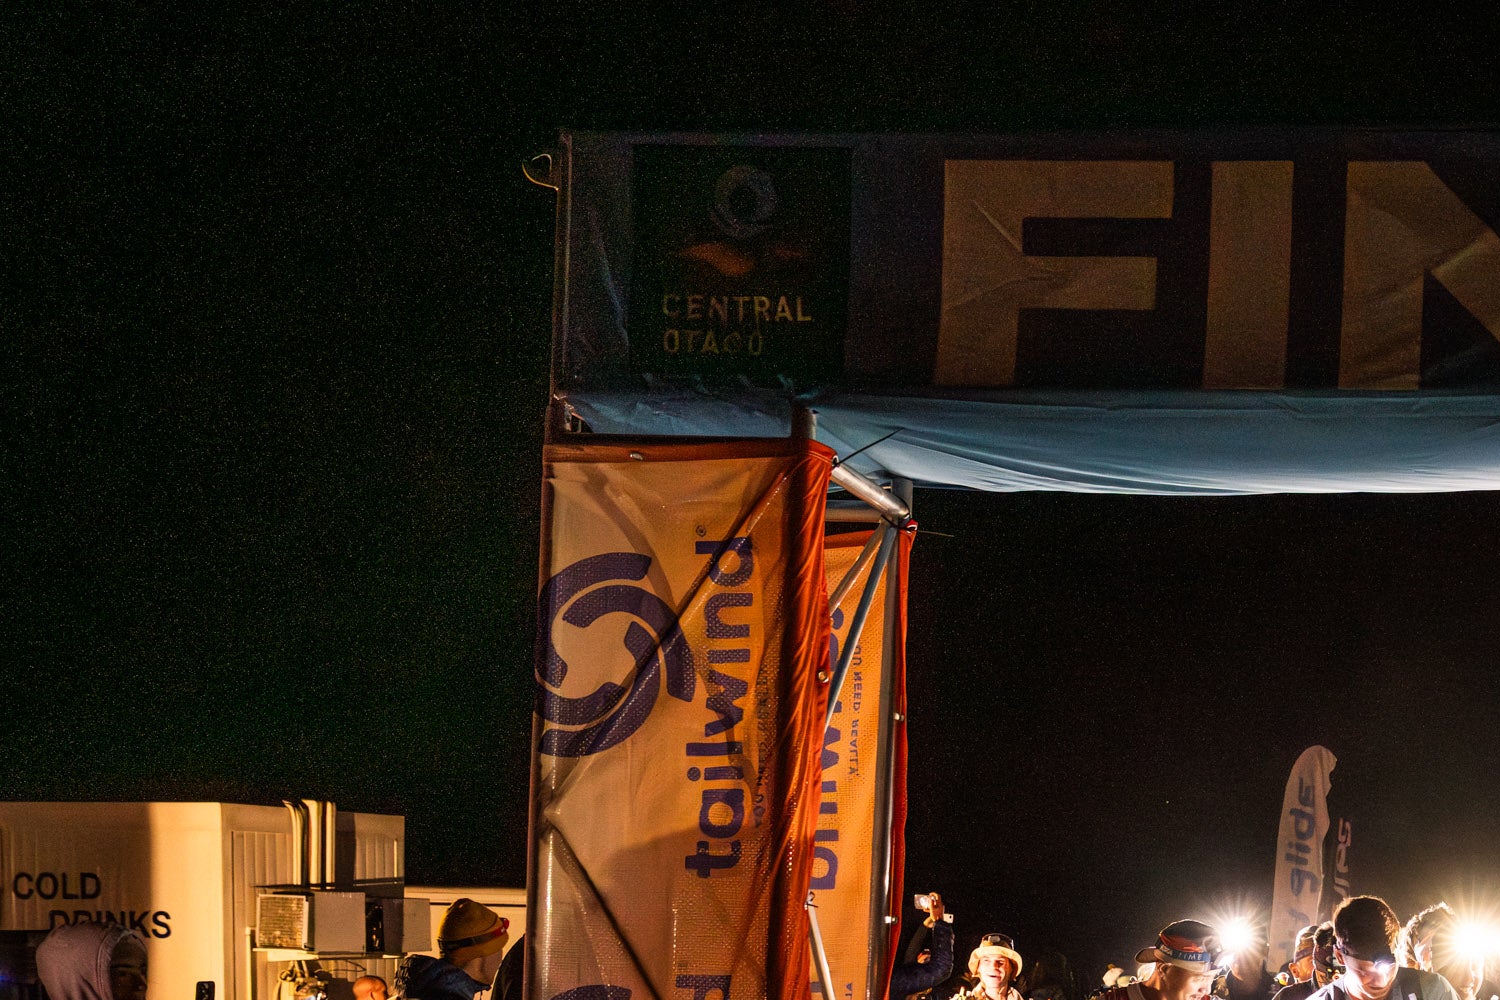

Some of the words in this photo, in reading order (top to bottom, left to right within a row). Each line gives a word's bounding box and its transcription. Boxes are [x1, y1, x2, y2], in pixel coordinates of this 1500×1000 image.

[661, 293, 812, 324] CENTRAL
[685, 536, 755, 879] tailwind
[13, 872, 100, 899] COLD
[50, 910, 171, 938] DRINKS
